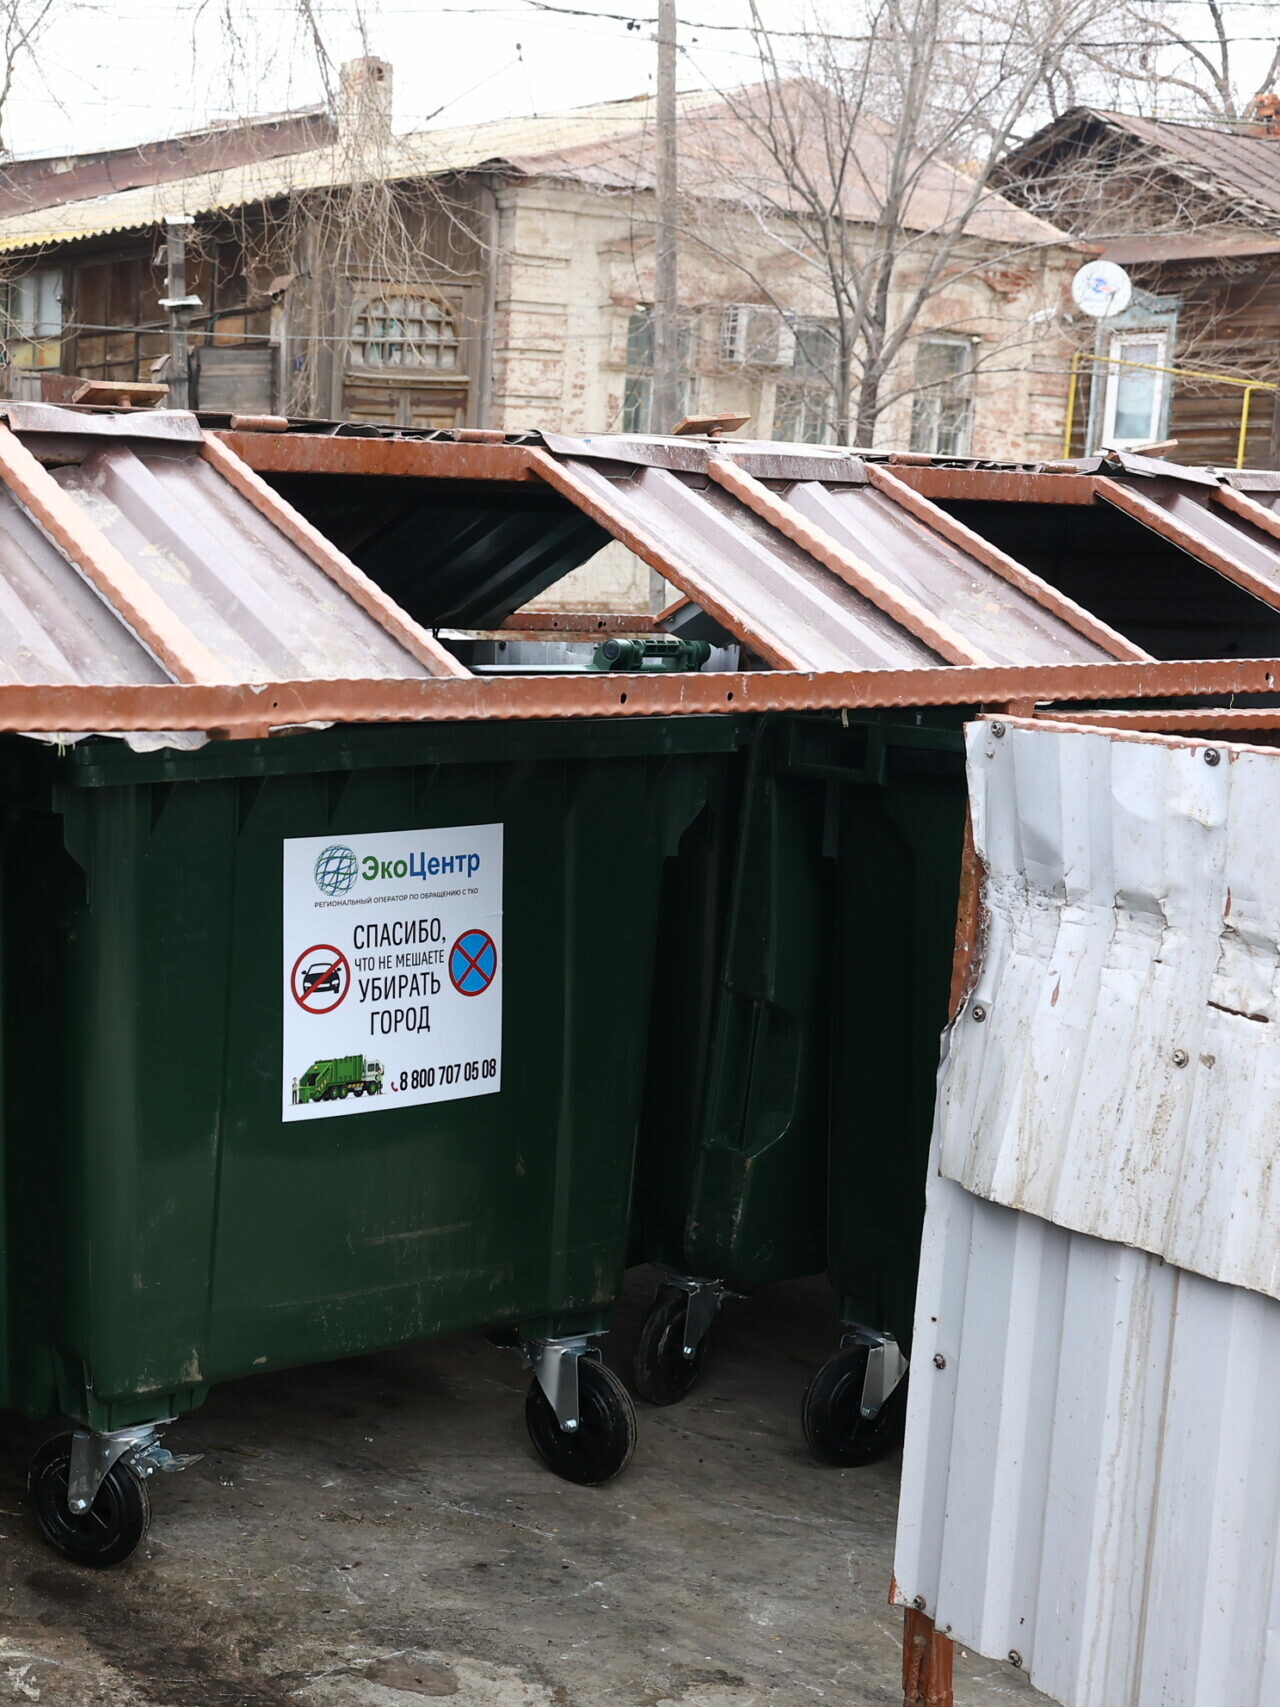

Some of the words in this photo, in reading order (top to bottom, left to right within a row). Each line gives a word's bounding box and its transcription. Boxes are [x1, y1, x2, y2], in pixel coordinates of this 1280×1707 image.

[361, 852, 480, 881] ЭкоЦентр
[314, 896, 372, 908] РЕГИОНАЛЬНЫЙ
[373, 894, 408, 904] ОПЕРАТОР
[409, 893, 419, 901] ПО
[420, 889, 461, 900] ОБРАЩЕНИЮ
[467, 887, 479, 895] ТКО
[353, 917, 446, 949] СПАСИБО,
[354, 956, 375, 972] ЧТО
[378, 954, 392, 970] НЕ
[395, 949, 445, 968] МЕШАЕТЕ
[359, 971, 441, 1003] УБИРАТЬ
[370, 1006, 430, 1036] ГОРОД
[400, 1071, 408, 1091] 8
[411, 1068, 435, 1089] 800
[439, 1064, 461, 1085] 707
[464, 1061, 478, 1081] 05
[482, 1058, 496, 1078] 08
